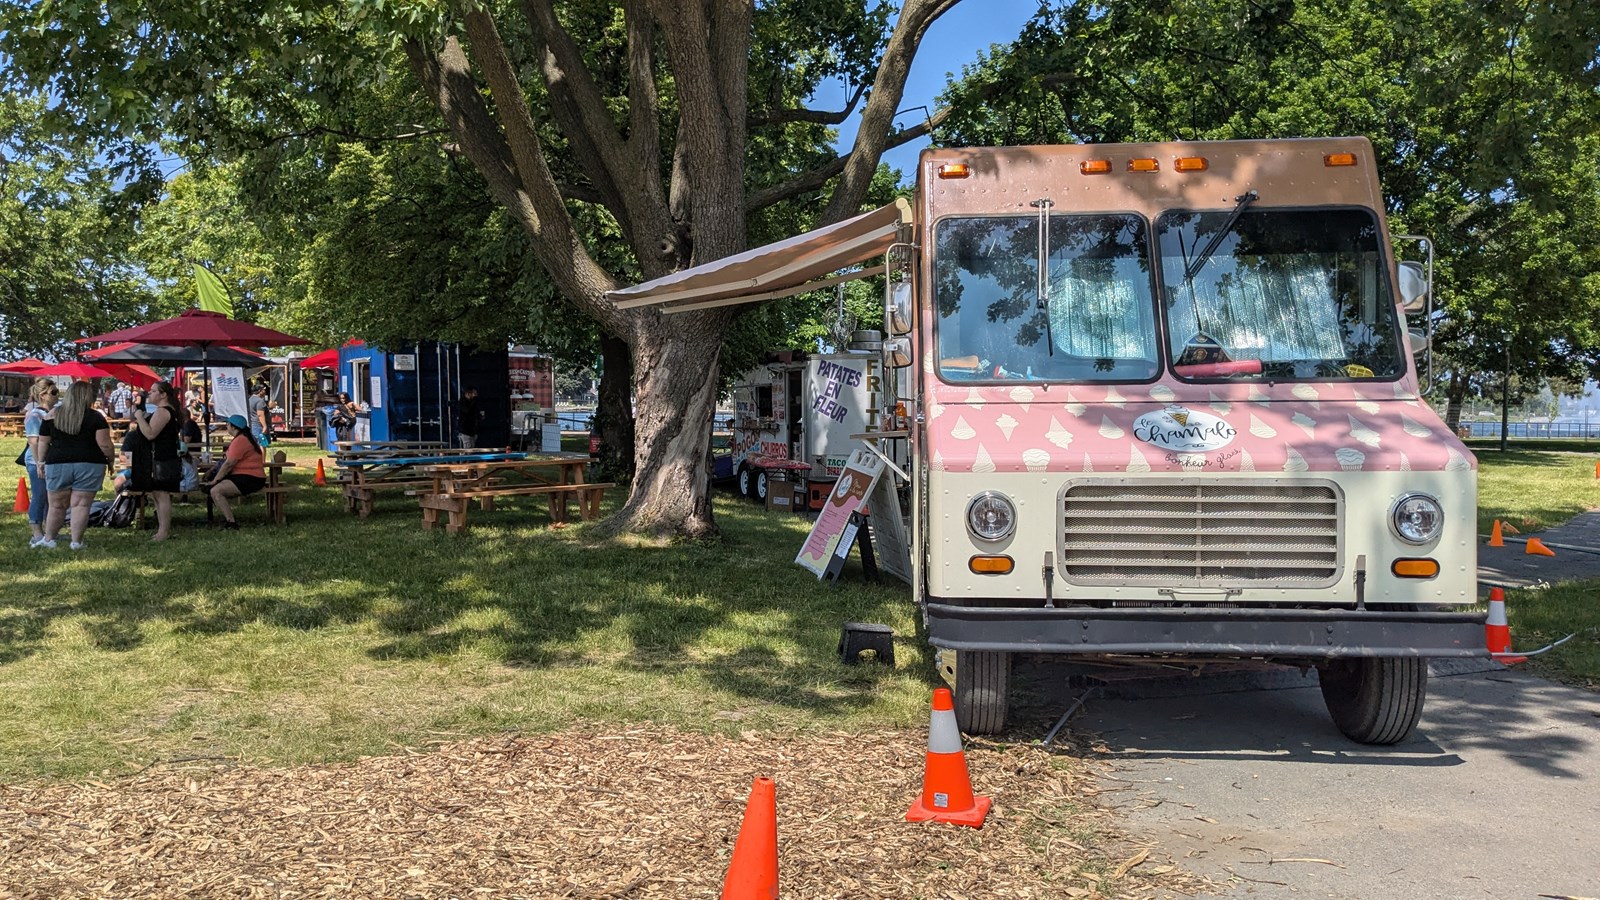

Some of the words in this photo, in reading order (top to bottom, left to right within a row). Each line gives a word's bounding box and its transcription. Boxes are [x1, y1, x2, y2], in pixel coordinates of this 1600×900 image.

[817, 360, 862, 387] PATATES
[824, 380, 842, 400] EN
[813, 395, 848, 424] FLEUR
[760, 441, 787, 459] CHURROS
[1165, 452, 1213, 467] bonheur
